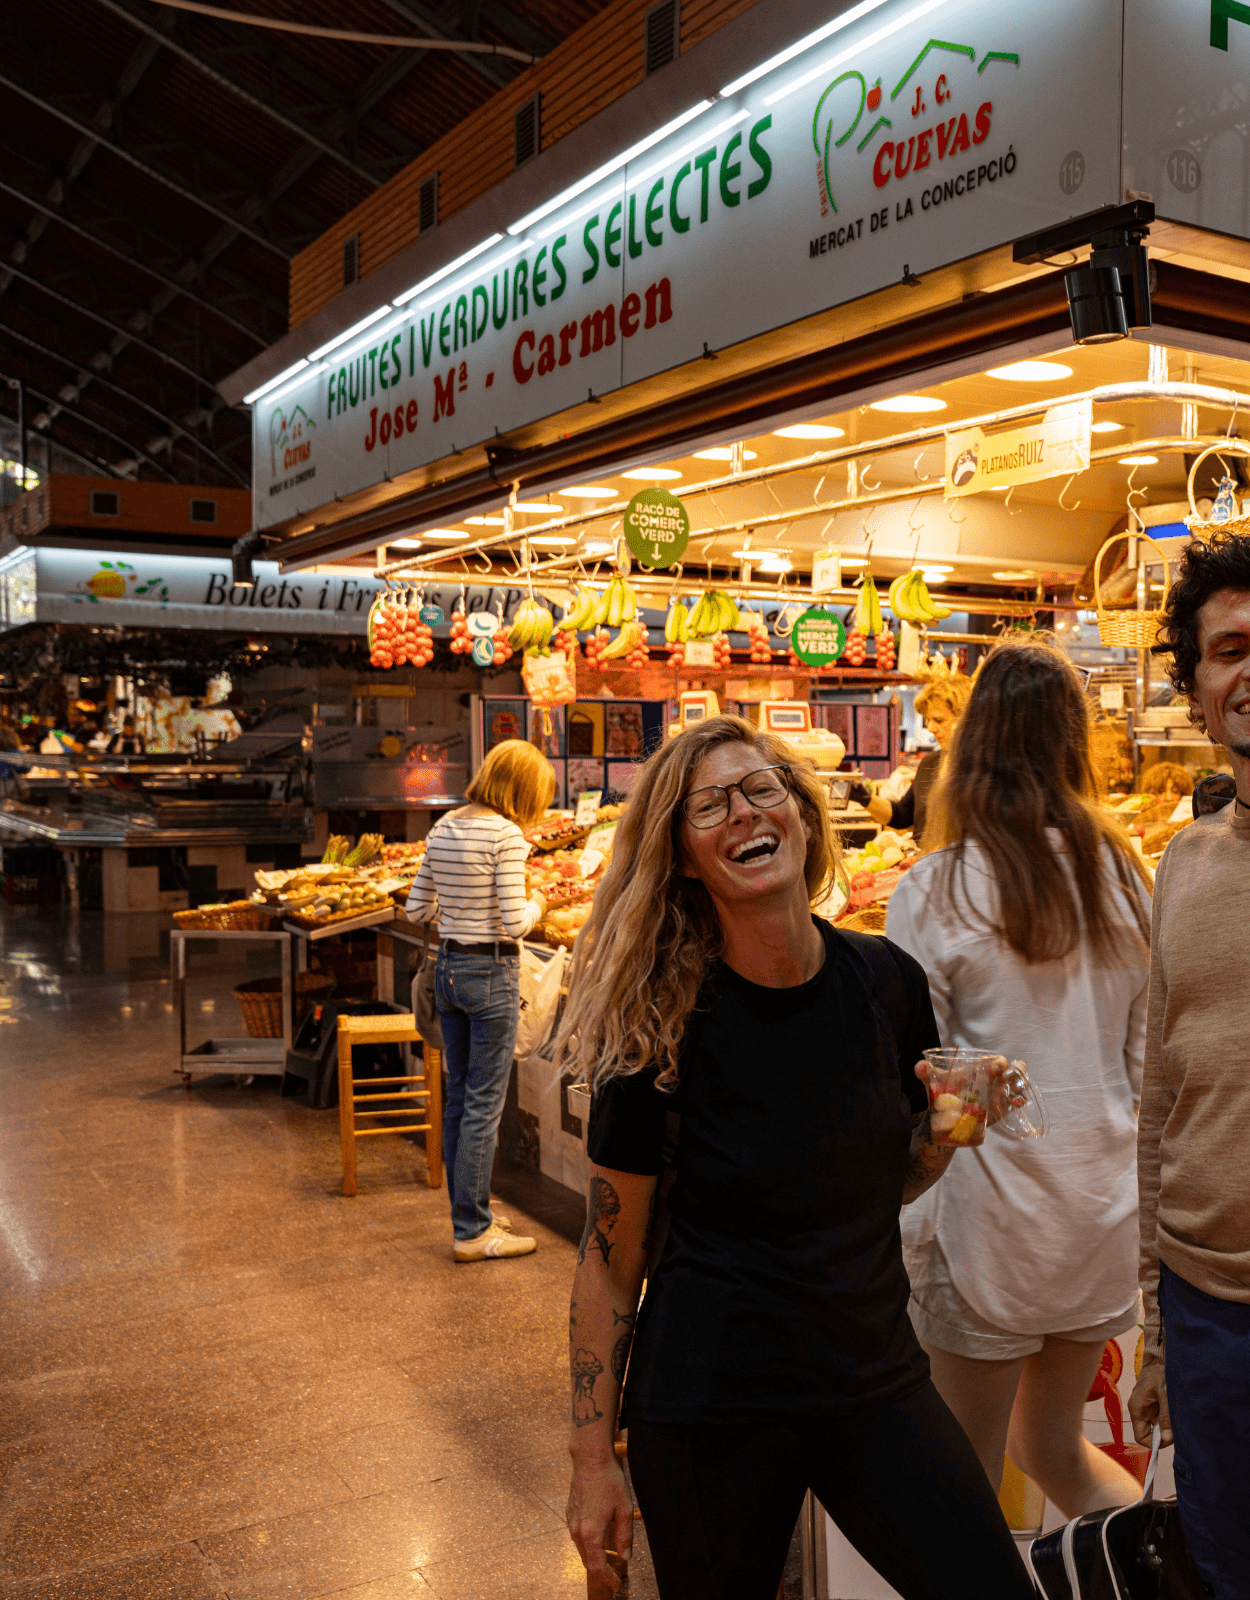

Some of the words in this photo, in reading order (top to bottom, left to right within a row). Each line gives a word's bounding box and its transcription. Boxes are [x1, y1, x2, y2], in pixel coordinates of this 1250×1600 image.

[873, 101, 992, 188] CUEVAS
[809, 217, 864, 259] MERCAT
[870, 207, 889, 233] DE
[896, 197, 914, 222] LA
[921, 144, 1018, 212] CONCEPCIÓ
[328, 340, 402, 420] FRUITES
[420, 234, 567, 368] VERDURES
[583, 113, 773, 285] SELECTES
[364, 397, 418, 452] Jose
[512, 276, 674, 385] Carmen
[629, 512, 685, 534] COMERÇ
[636, 502, 665, 515] RACÓ
[666, 506, 680, 517] DE
[639, 527, 675, 543] VERD
[203, 573, 303, 609] Bolets
[318, 580, 331, 610] i
[798, 641, 839, 655] VERD
